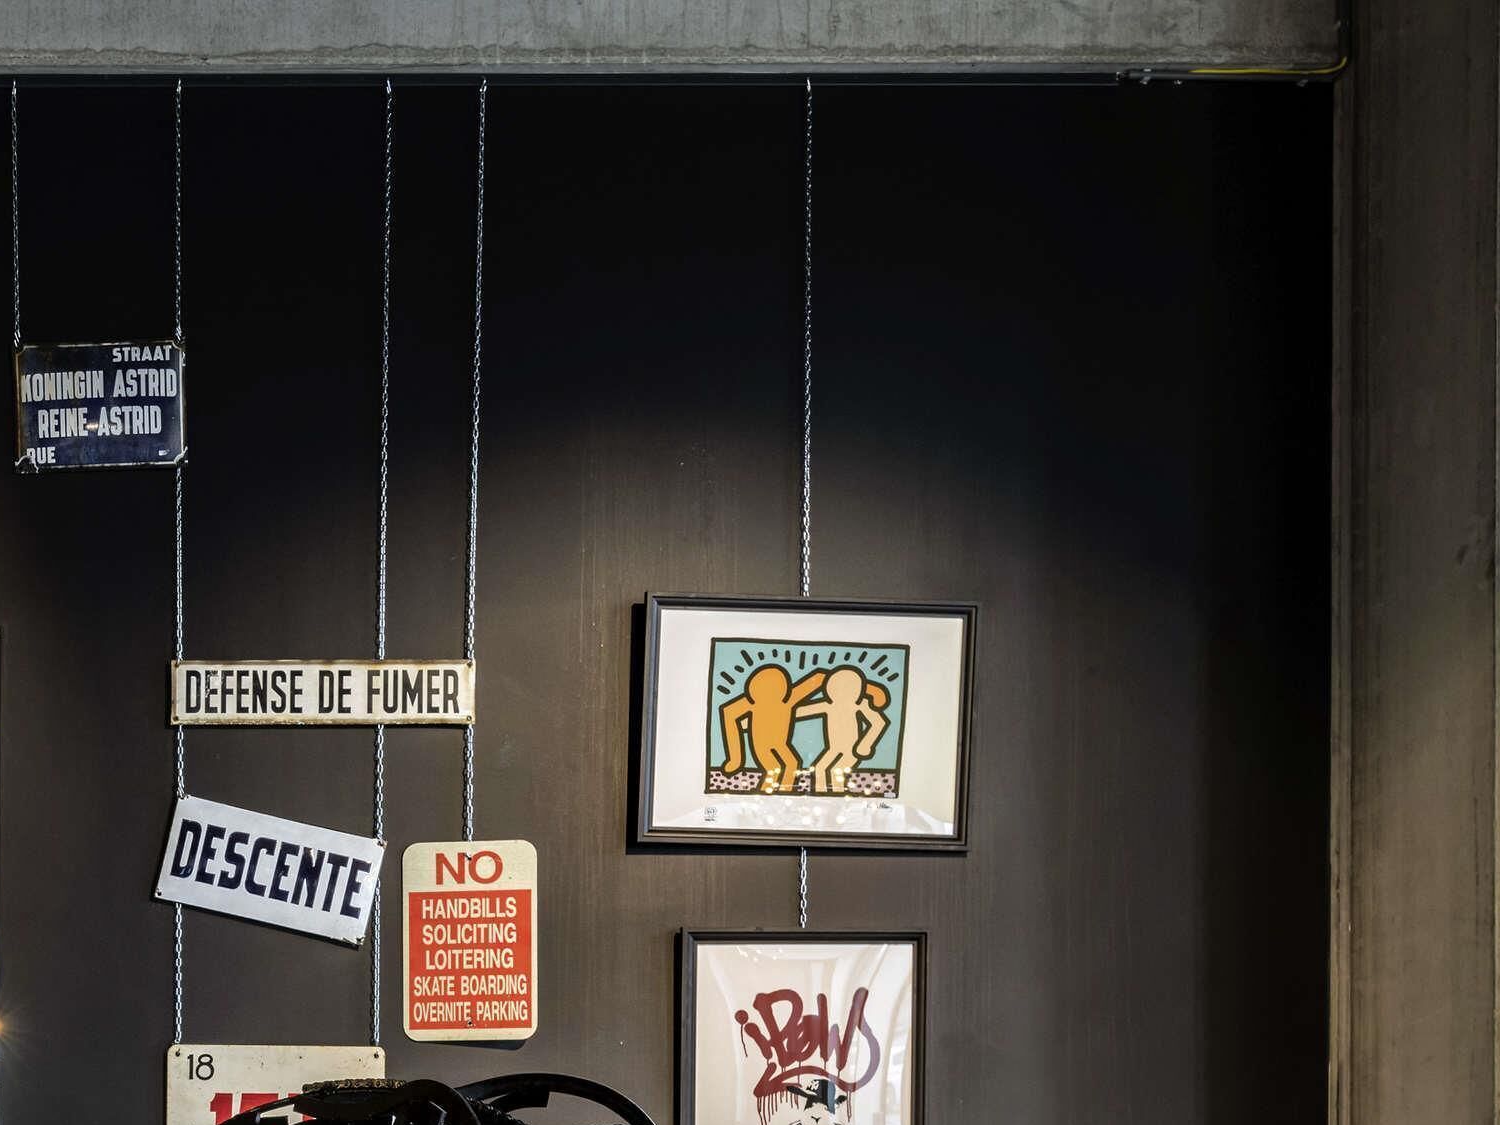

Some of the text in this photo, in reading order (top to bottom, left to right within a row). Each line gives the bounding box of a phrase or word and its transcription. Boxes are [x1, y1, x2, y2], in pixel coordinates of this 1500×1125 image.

[112, 345, 172, 362] STRAAT
[21, 368, 177, 402] KONINGIN ASTRID
[27, 447, 56, 464] RUE
[185, 669, 460, 714] DEFENSE DE FUMER
[170, 818, 372, 920] DESCENTE
[435, 850, 504, 886] NO
[422, 896, 517, 920] HANDBILLS
[422, 923, 517, 945] SOLICITING
[425, 948, 514, 970] LOITERING
[413, 974, 527, 997] SKATE BOARDING
[413, 1000, 528, 1023] OVERNITE PARKING
[187, 1053, 215, 1081] 18
